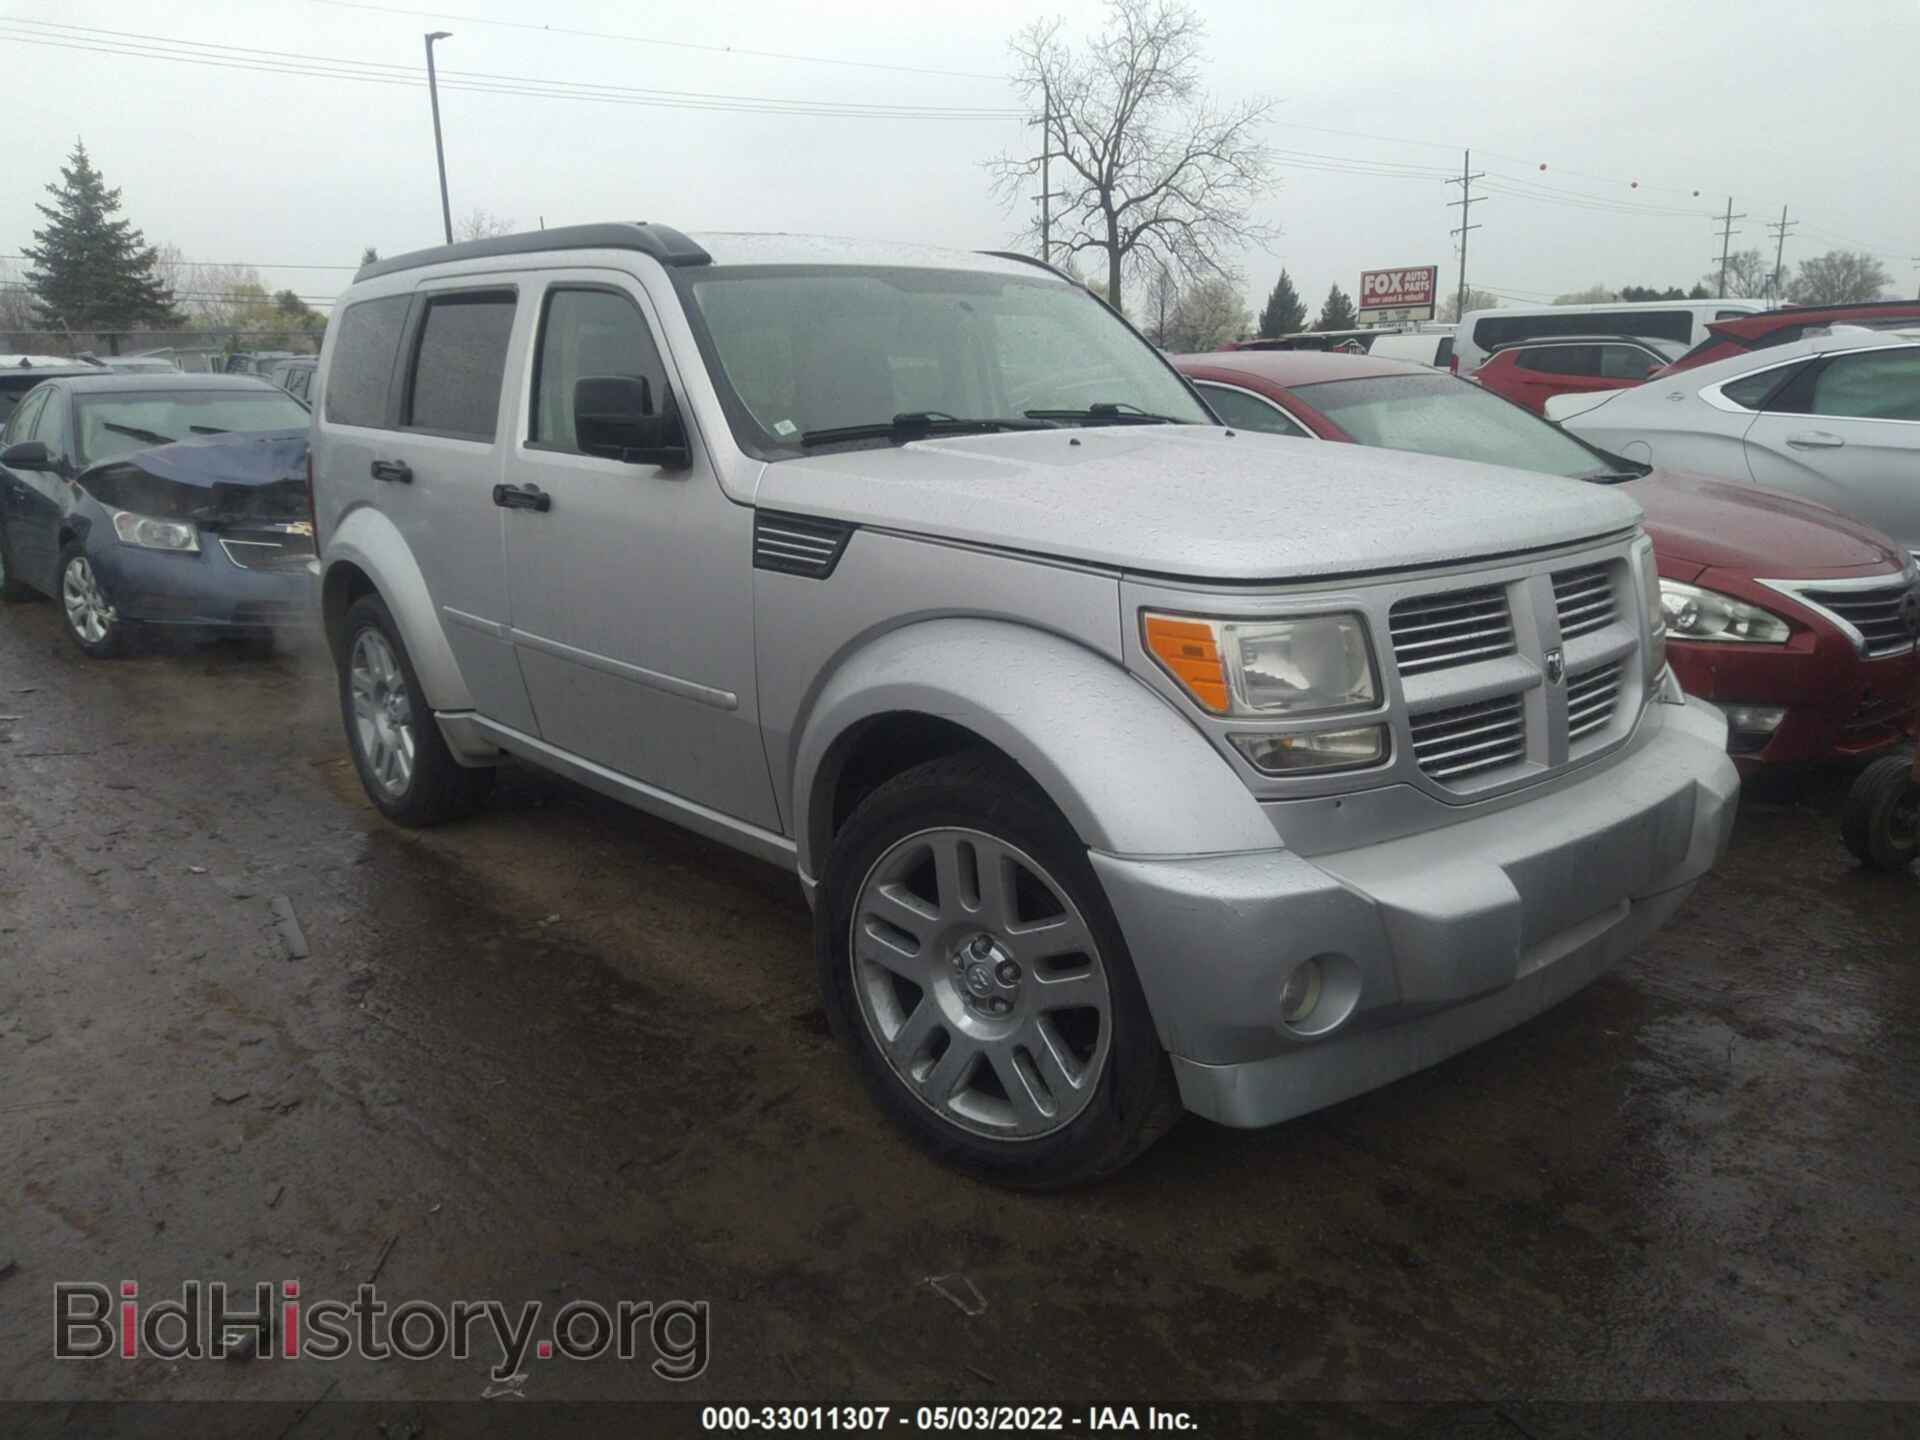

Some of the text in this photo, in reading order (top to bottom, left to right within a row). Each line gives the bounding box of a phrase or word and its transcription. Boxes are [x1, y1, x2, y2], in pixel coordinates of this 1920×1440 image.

[1405, 270, 1429, 281] AUTO
[1364, 272, 1403, 295] FOX
[1404, 280, 1430, 292] PARTS
